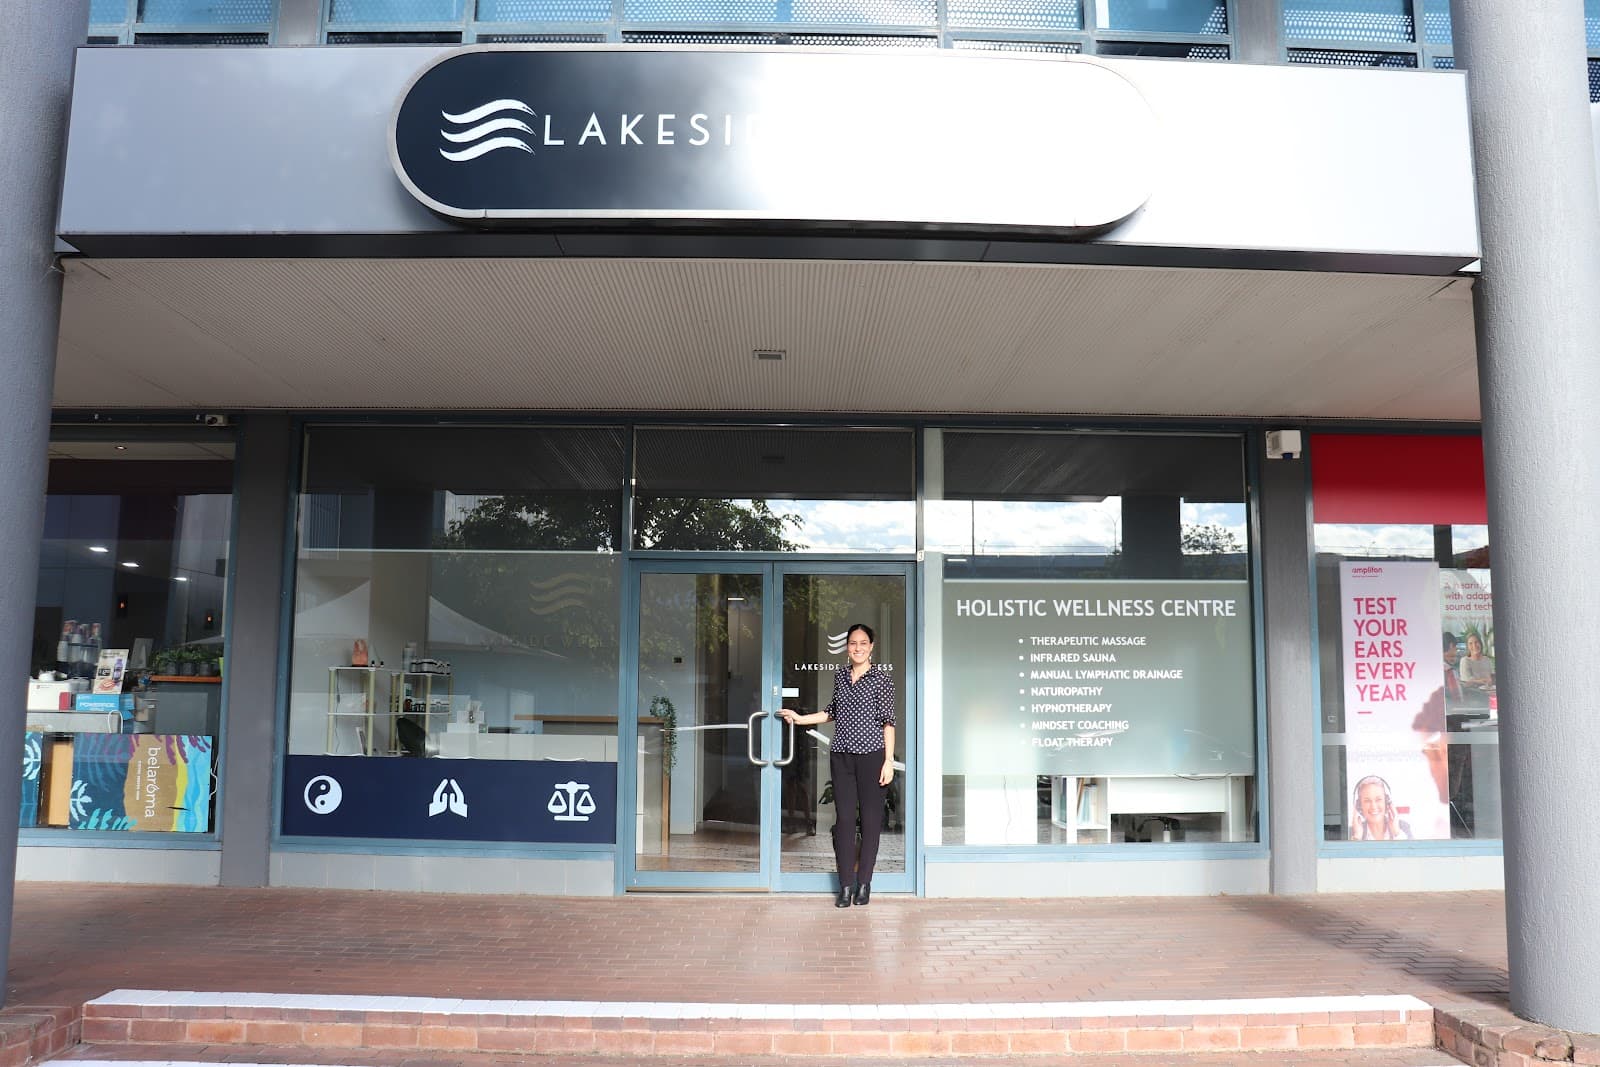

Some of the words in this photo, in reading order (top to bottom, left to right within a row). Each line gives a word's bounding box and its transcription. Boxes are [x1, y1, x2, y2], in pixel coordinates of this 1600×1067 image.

[1352, 566, 1383, 575] amplifon
[957, 599, 1047, 617] HOLISTIC
[1053, 599, 1155, 617] WELLNESS
[1161, 599, 1237, 617] CENTRE
[1353, 597, 1397, 615] TEST
[1445, 602, 1471, 611] sound
[1353, 619, 1408, 637] YOUR
[1030, 636, 1099, 646] THERAPEUTIC
[1101, 636, 1147, 646] MASSAGE
[1354, 640, 1403, 658] EARS
[1030, 653, 1080, 663] INFRARED
[1082, 653, 1116, 663] SAUNA
[1030, 670, 1073, 680] MANUAL
[1075, 670, 1130, 680] LYMPHATIC
[1132, 670, 1184, 680] DRAINAGE
[1355, 662, 1416, 680] EVERY
[1031, 686, 1104, 697] NATUROPATHY
[1356, 683, 1407, 702] YEAR
[1031, 703, 1113, 713] HYPNOTHERAPY
[1032, 720, 1075, 731] MINDSET
[1077, 720, 1130, 730] COACHING
[1032, 737, 1065, 748] FLOAT
[1067, 737, 1114, 747] THERAPY
